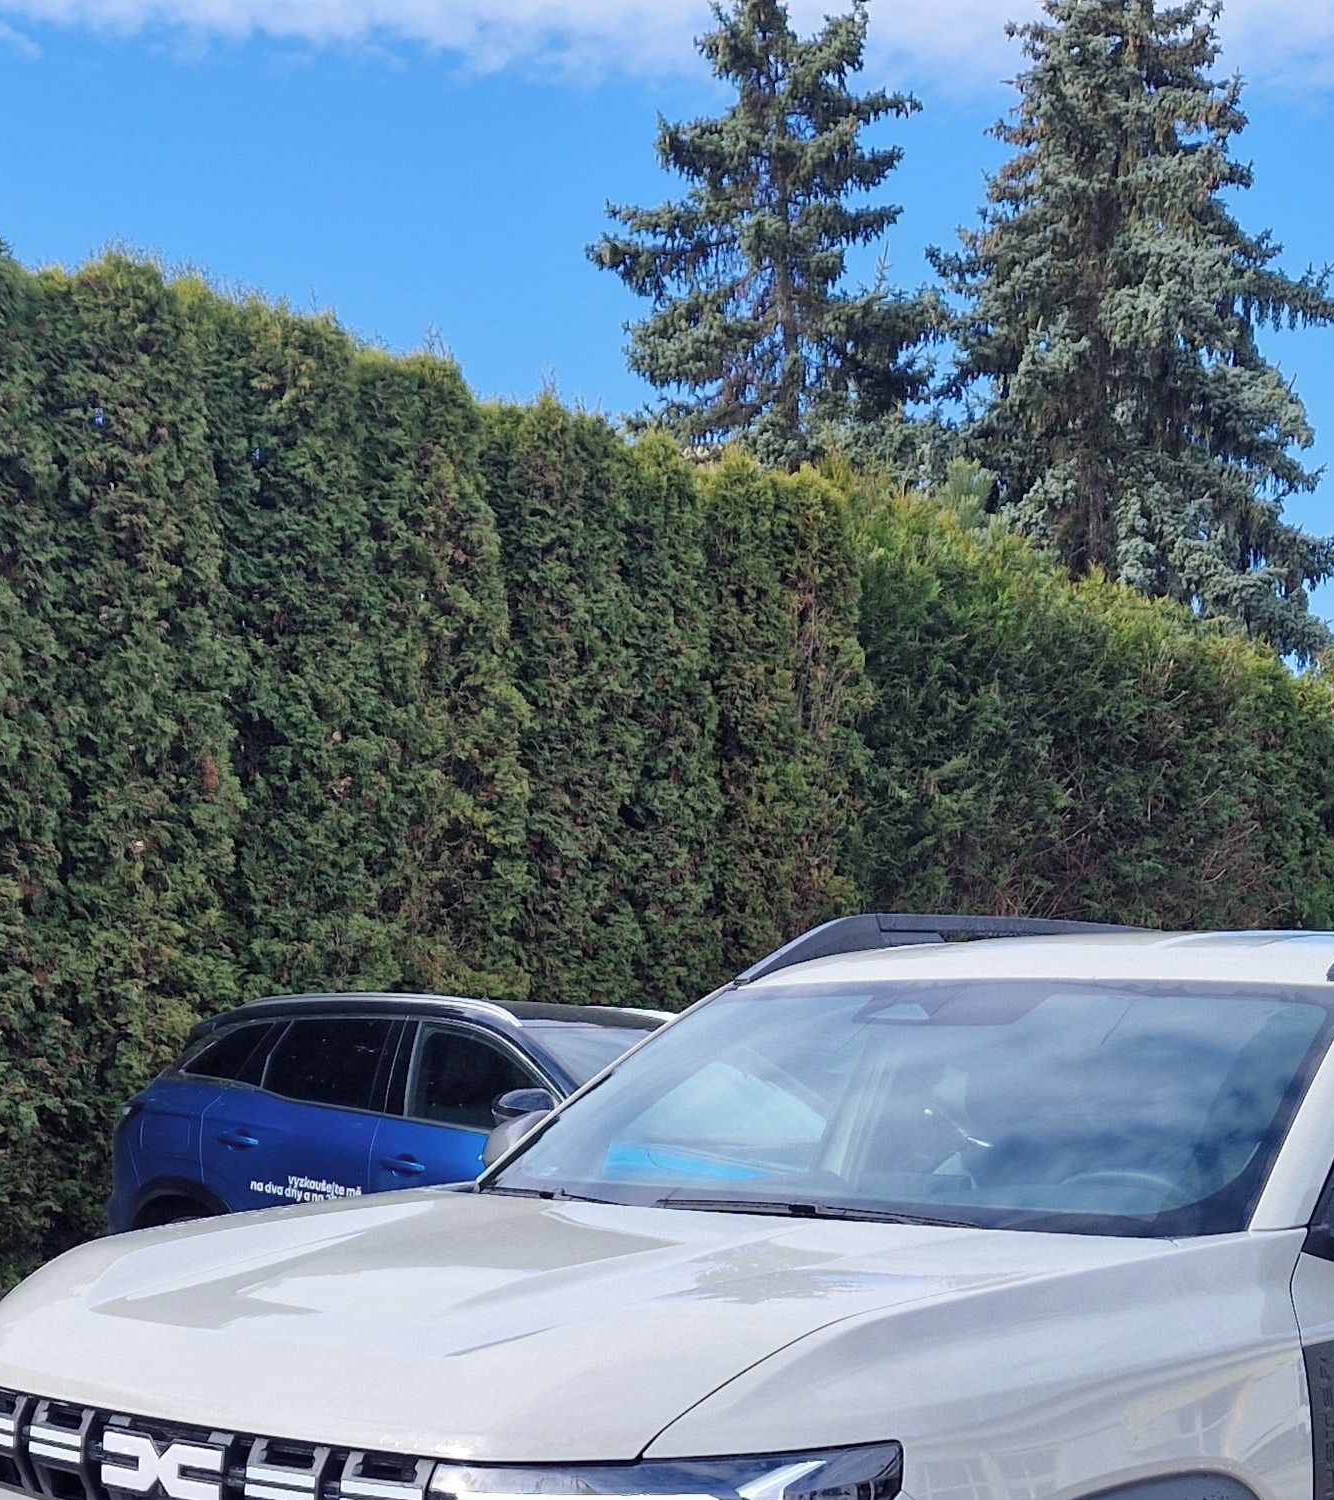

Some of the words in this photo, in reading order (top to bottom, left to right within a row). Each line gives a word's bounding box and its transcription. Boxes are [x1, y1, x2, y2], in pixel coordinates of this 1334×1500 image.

[250, 1180, 264, 1192] na
[265, 1181, 284, 1195] dva
[285, 1186, 303, 1202] dny
[303, 1191, 311, 1202] a
[288, 1175, 345, 1197] vyzkoušejte
